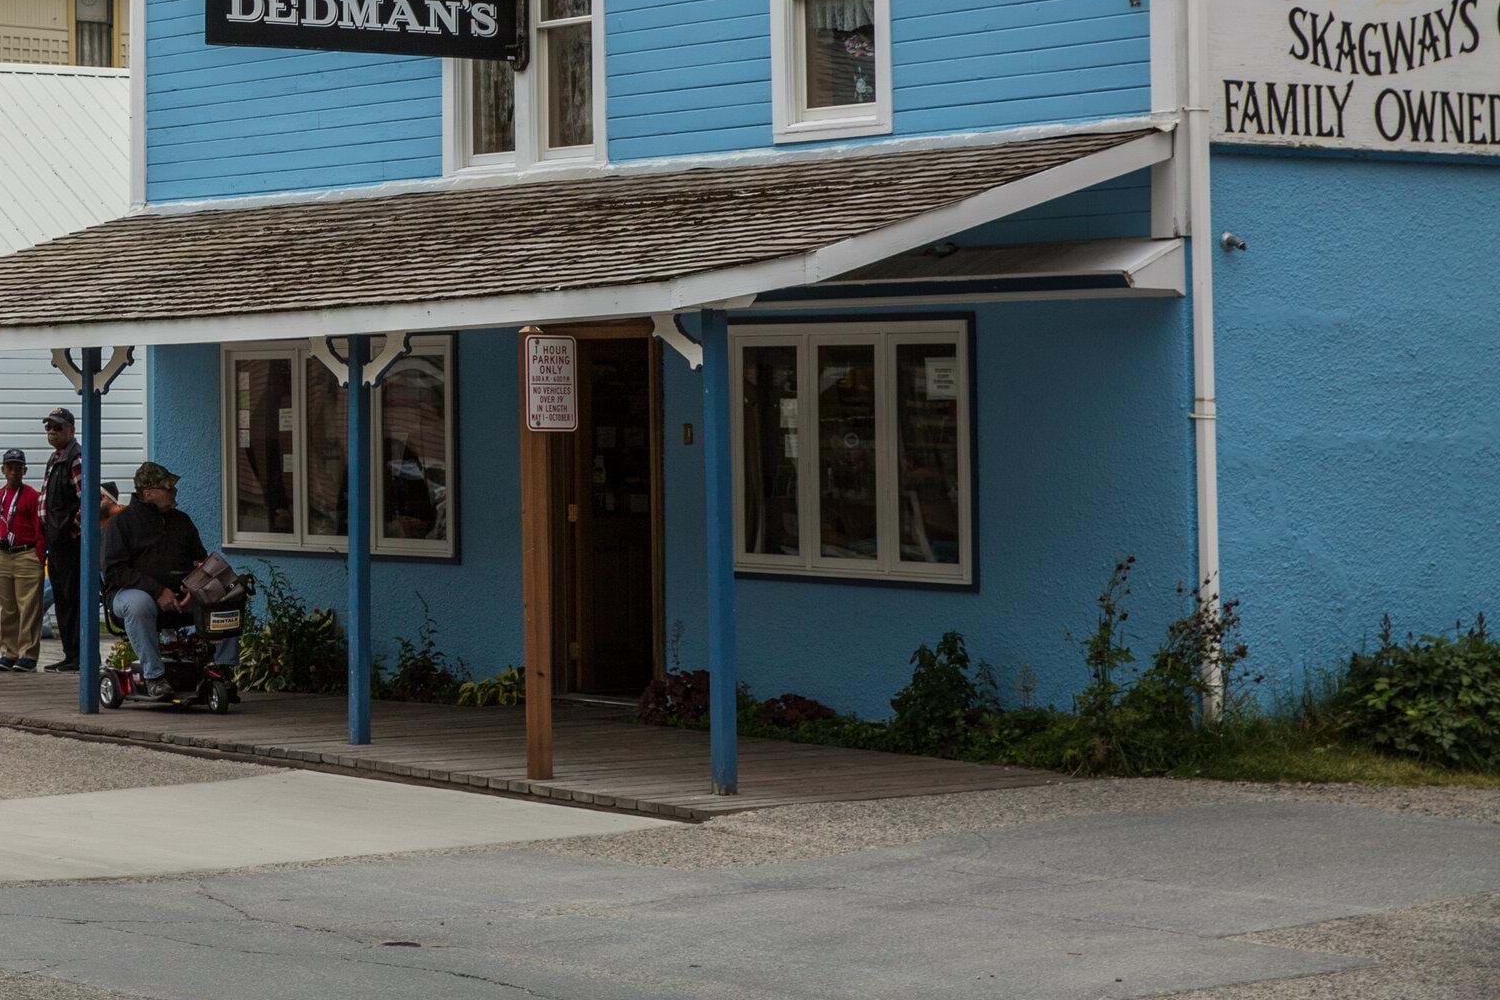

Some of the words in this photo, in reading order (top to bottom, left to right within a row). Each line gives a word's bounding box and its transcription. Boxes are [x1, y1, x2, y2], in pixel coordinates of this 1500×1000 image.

[1222, 79, 1354, 138] FAMILY
[543, 345, 567, 355] HOUR
[532, 355, 570, 365] PARKING
[539, 365, 563, 374] ONLY
[533, 386, 541, 394] NO
[543, 386, 571, 395] VEHICLES
[539, 395, 555, 403] OVER
[536, 404, 543, 412] IN
[545, 404, 567, 412] LENGTH
[531, 413, 541, 421] MAY
[549, 413, 570, 421] OCTOBER
